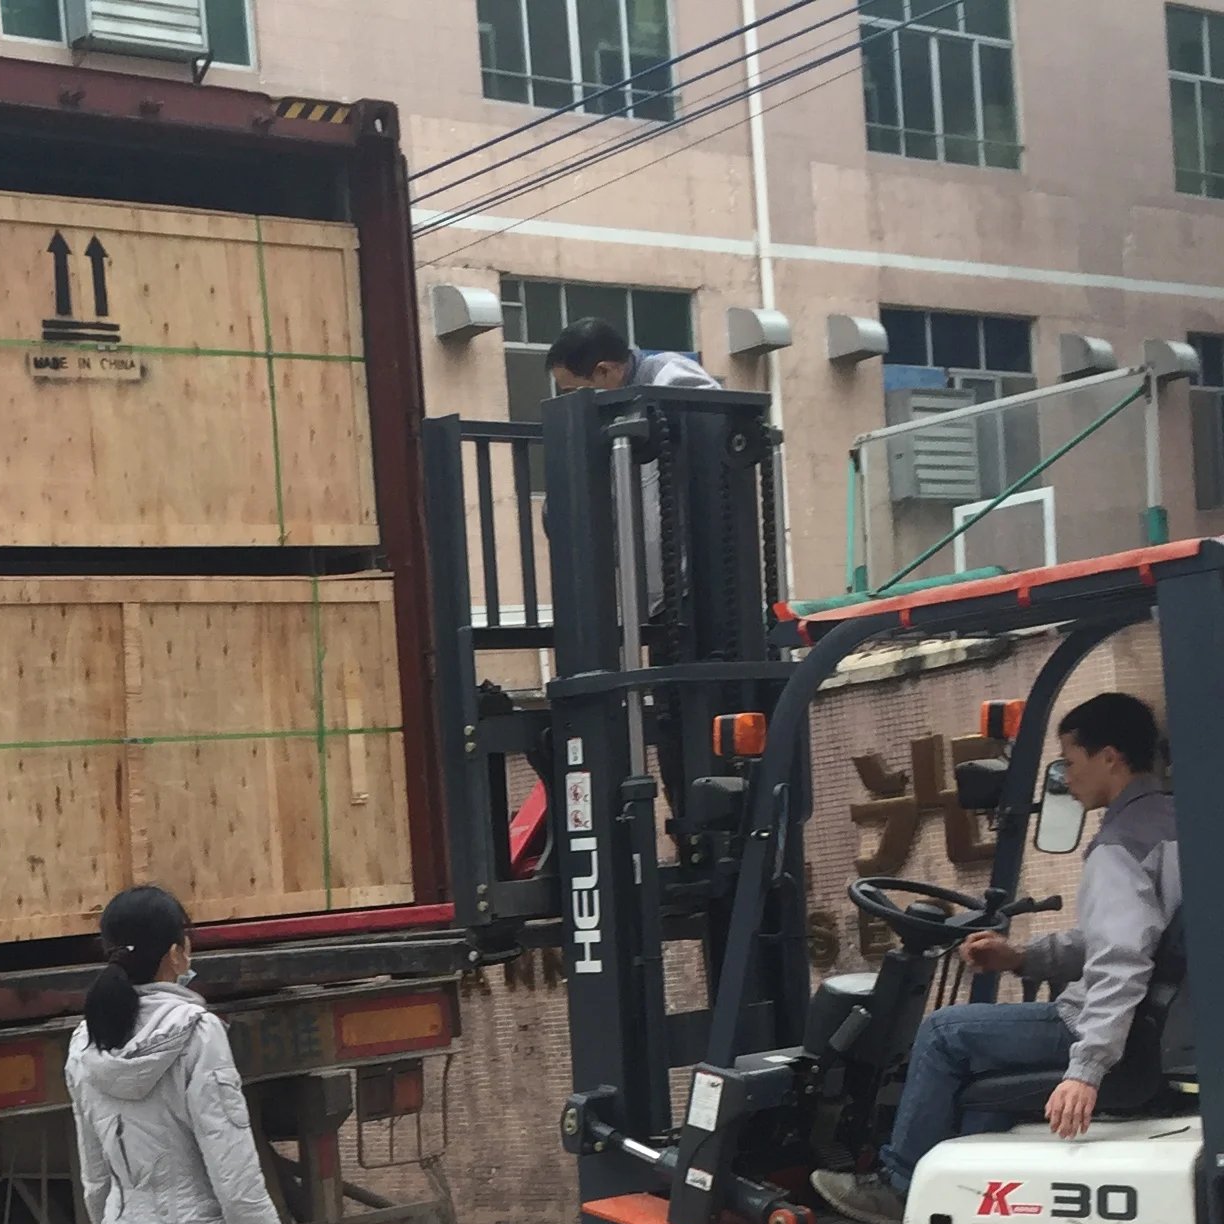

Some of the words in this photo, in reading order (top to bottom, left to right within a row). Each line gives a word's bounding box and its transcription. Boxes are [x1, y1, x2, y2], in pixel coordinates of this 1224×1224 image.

[77, 357, 92, 370] IN
[99, 357, 136, 371] CHINA
[569, 837, 602, 973] HELI
[1050, 1182, 1138, 1221] 30
